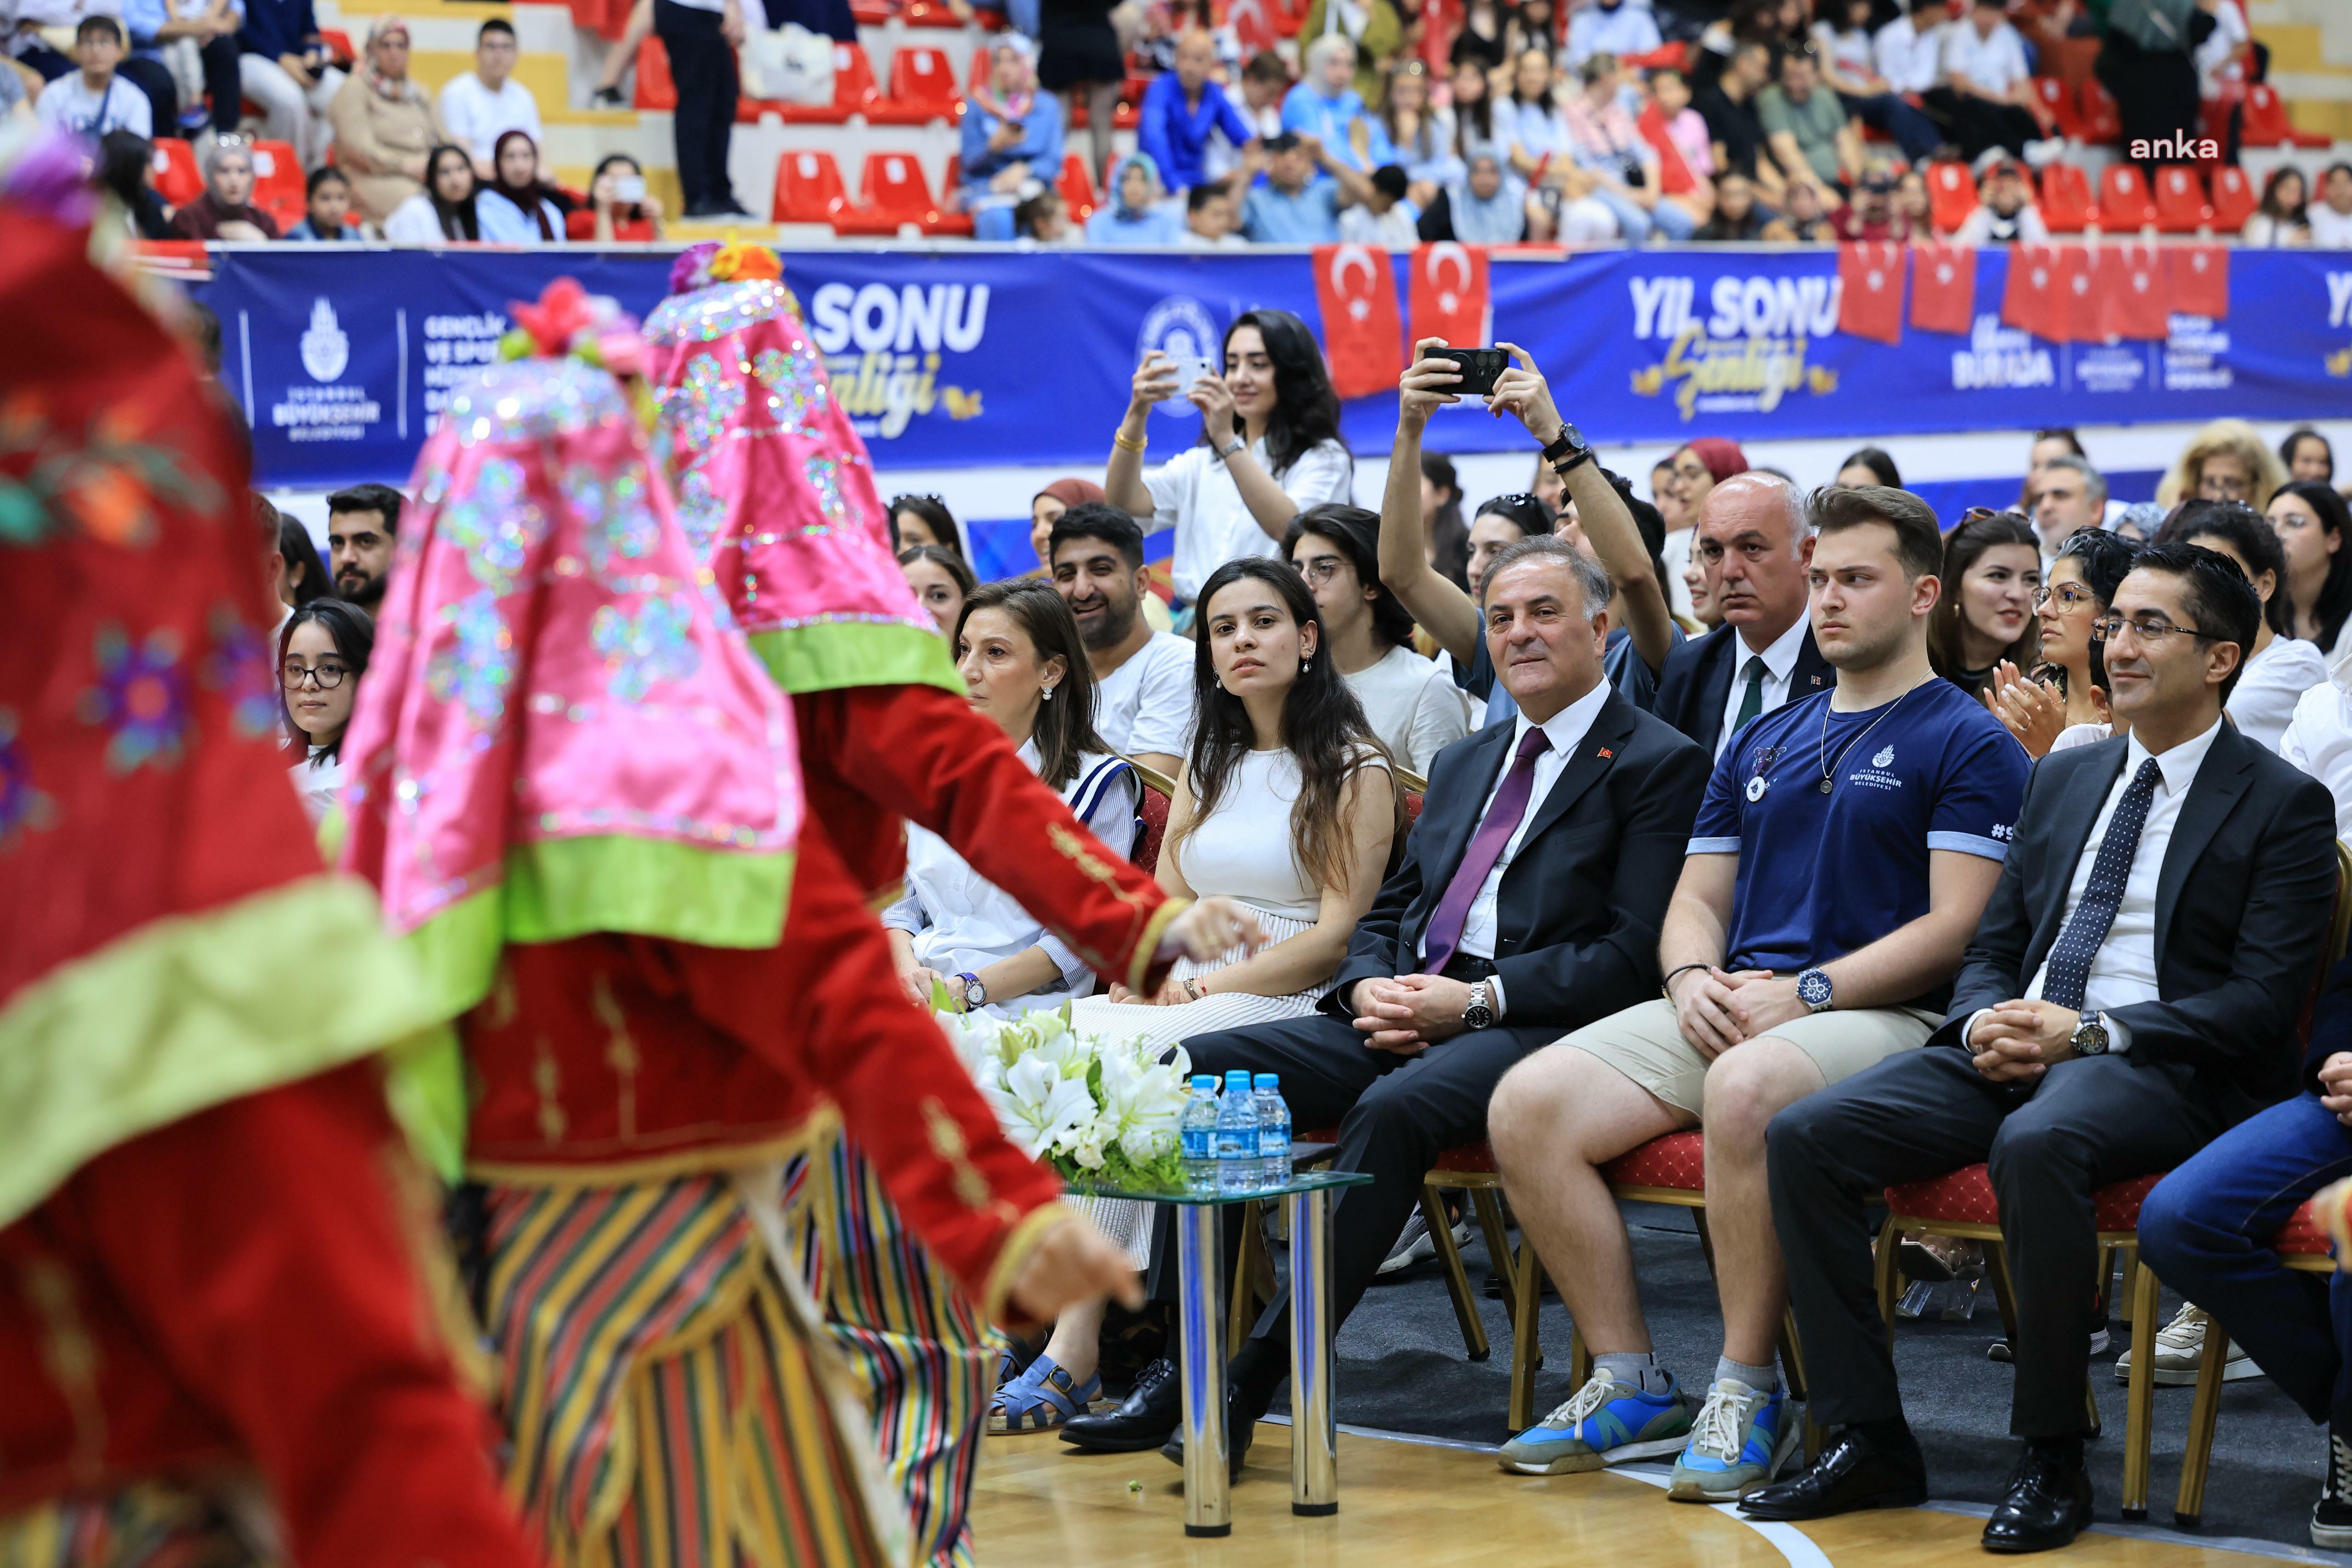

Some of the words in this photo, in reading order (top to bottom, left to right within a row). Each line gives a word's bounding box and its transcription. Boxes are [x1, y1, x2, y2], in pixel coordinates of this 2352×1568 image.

[811, 283, 990, 353] SONU
[1629, 277, 1703, 339] YIL
[1708, 276, 1843, 338] SONU
[1849, 773, 1902, 787] BÜYÜKŞEHİR
